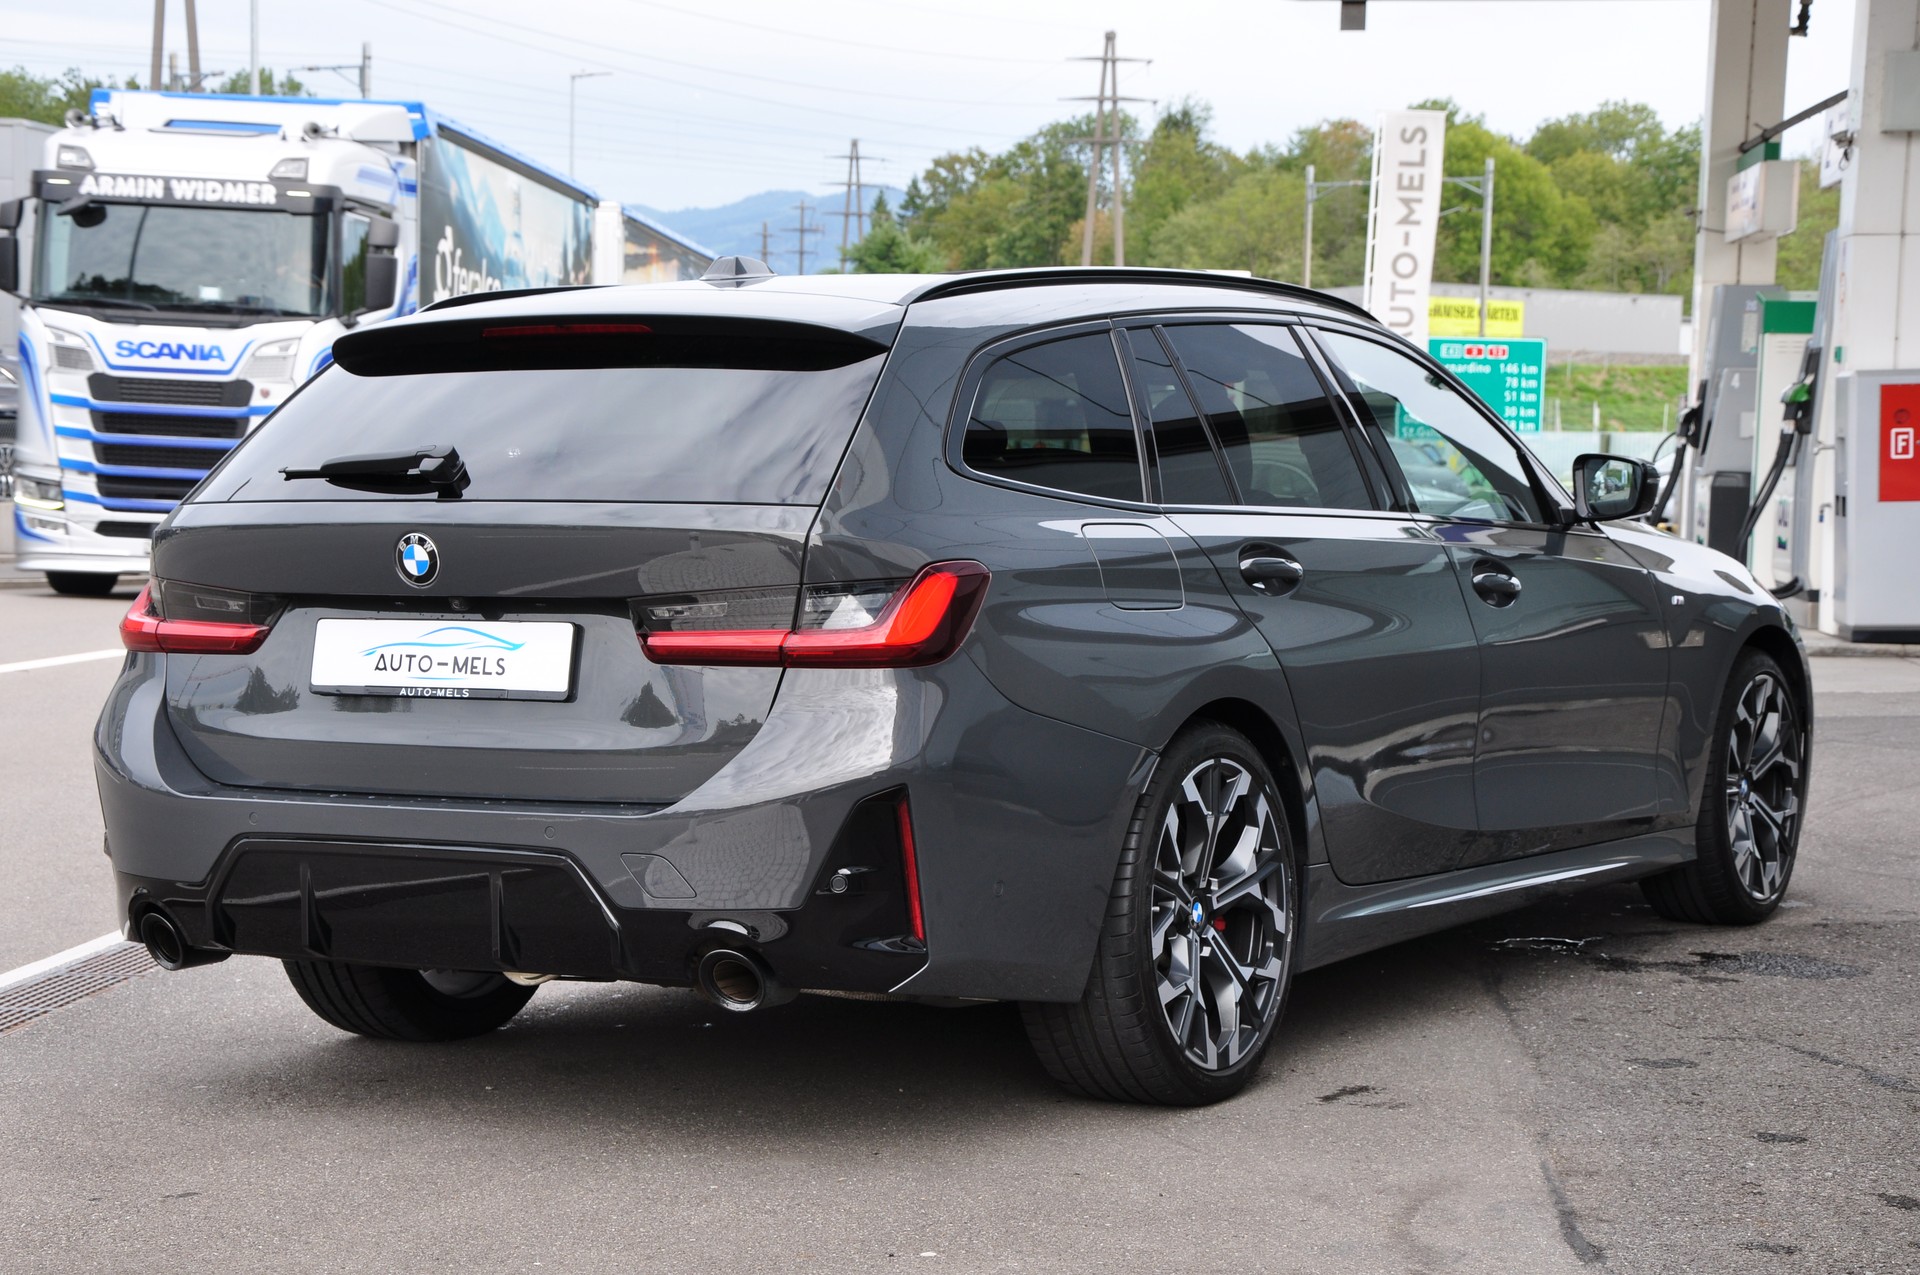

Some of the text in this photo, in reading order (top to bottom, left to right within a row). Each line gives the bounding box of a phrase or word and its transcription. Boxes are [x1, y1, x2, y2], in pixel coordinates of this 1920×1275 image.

[78, 174, 277, 205] ARMIN WIDMER
[1387, 125, 1428, 335] UTO-MELS
[115, 340, 225, 361] SCANIA
[1500, 363, 1519, 374] 146
[1521, 363, 1539, 374] km
[1521, 377, 1538, 389] km
[1731, 373, 1740, 389] 4
[1504, 390, 1537, 402] 51 km
[1520, 406, 1537, 417] km
[1519, 420, 1536, 431] km
[400, 535, 434, 552] BMW
[374, 653, 506, 676] AUTO-MELS
[399, 687, 470, 698] AUTO-MELS
